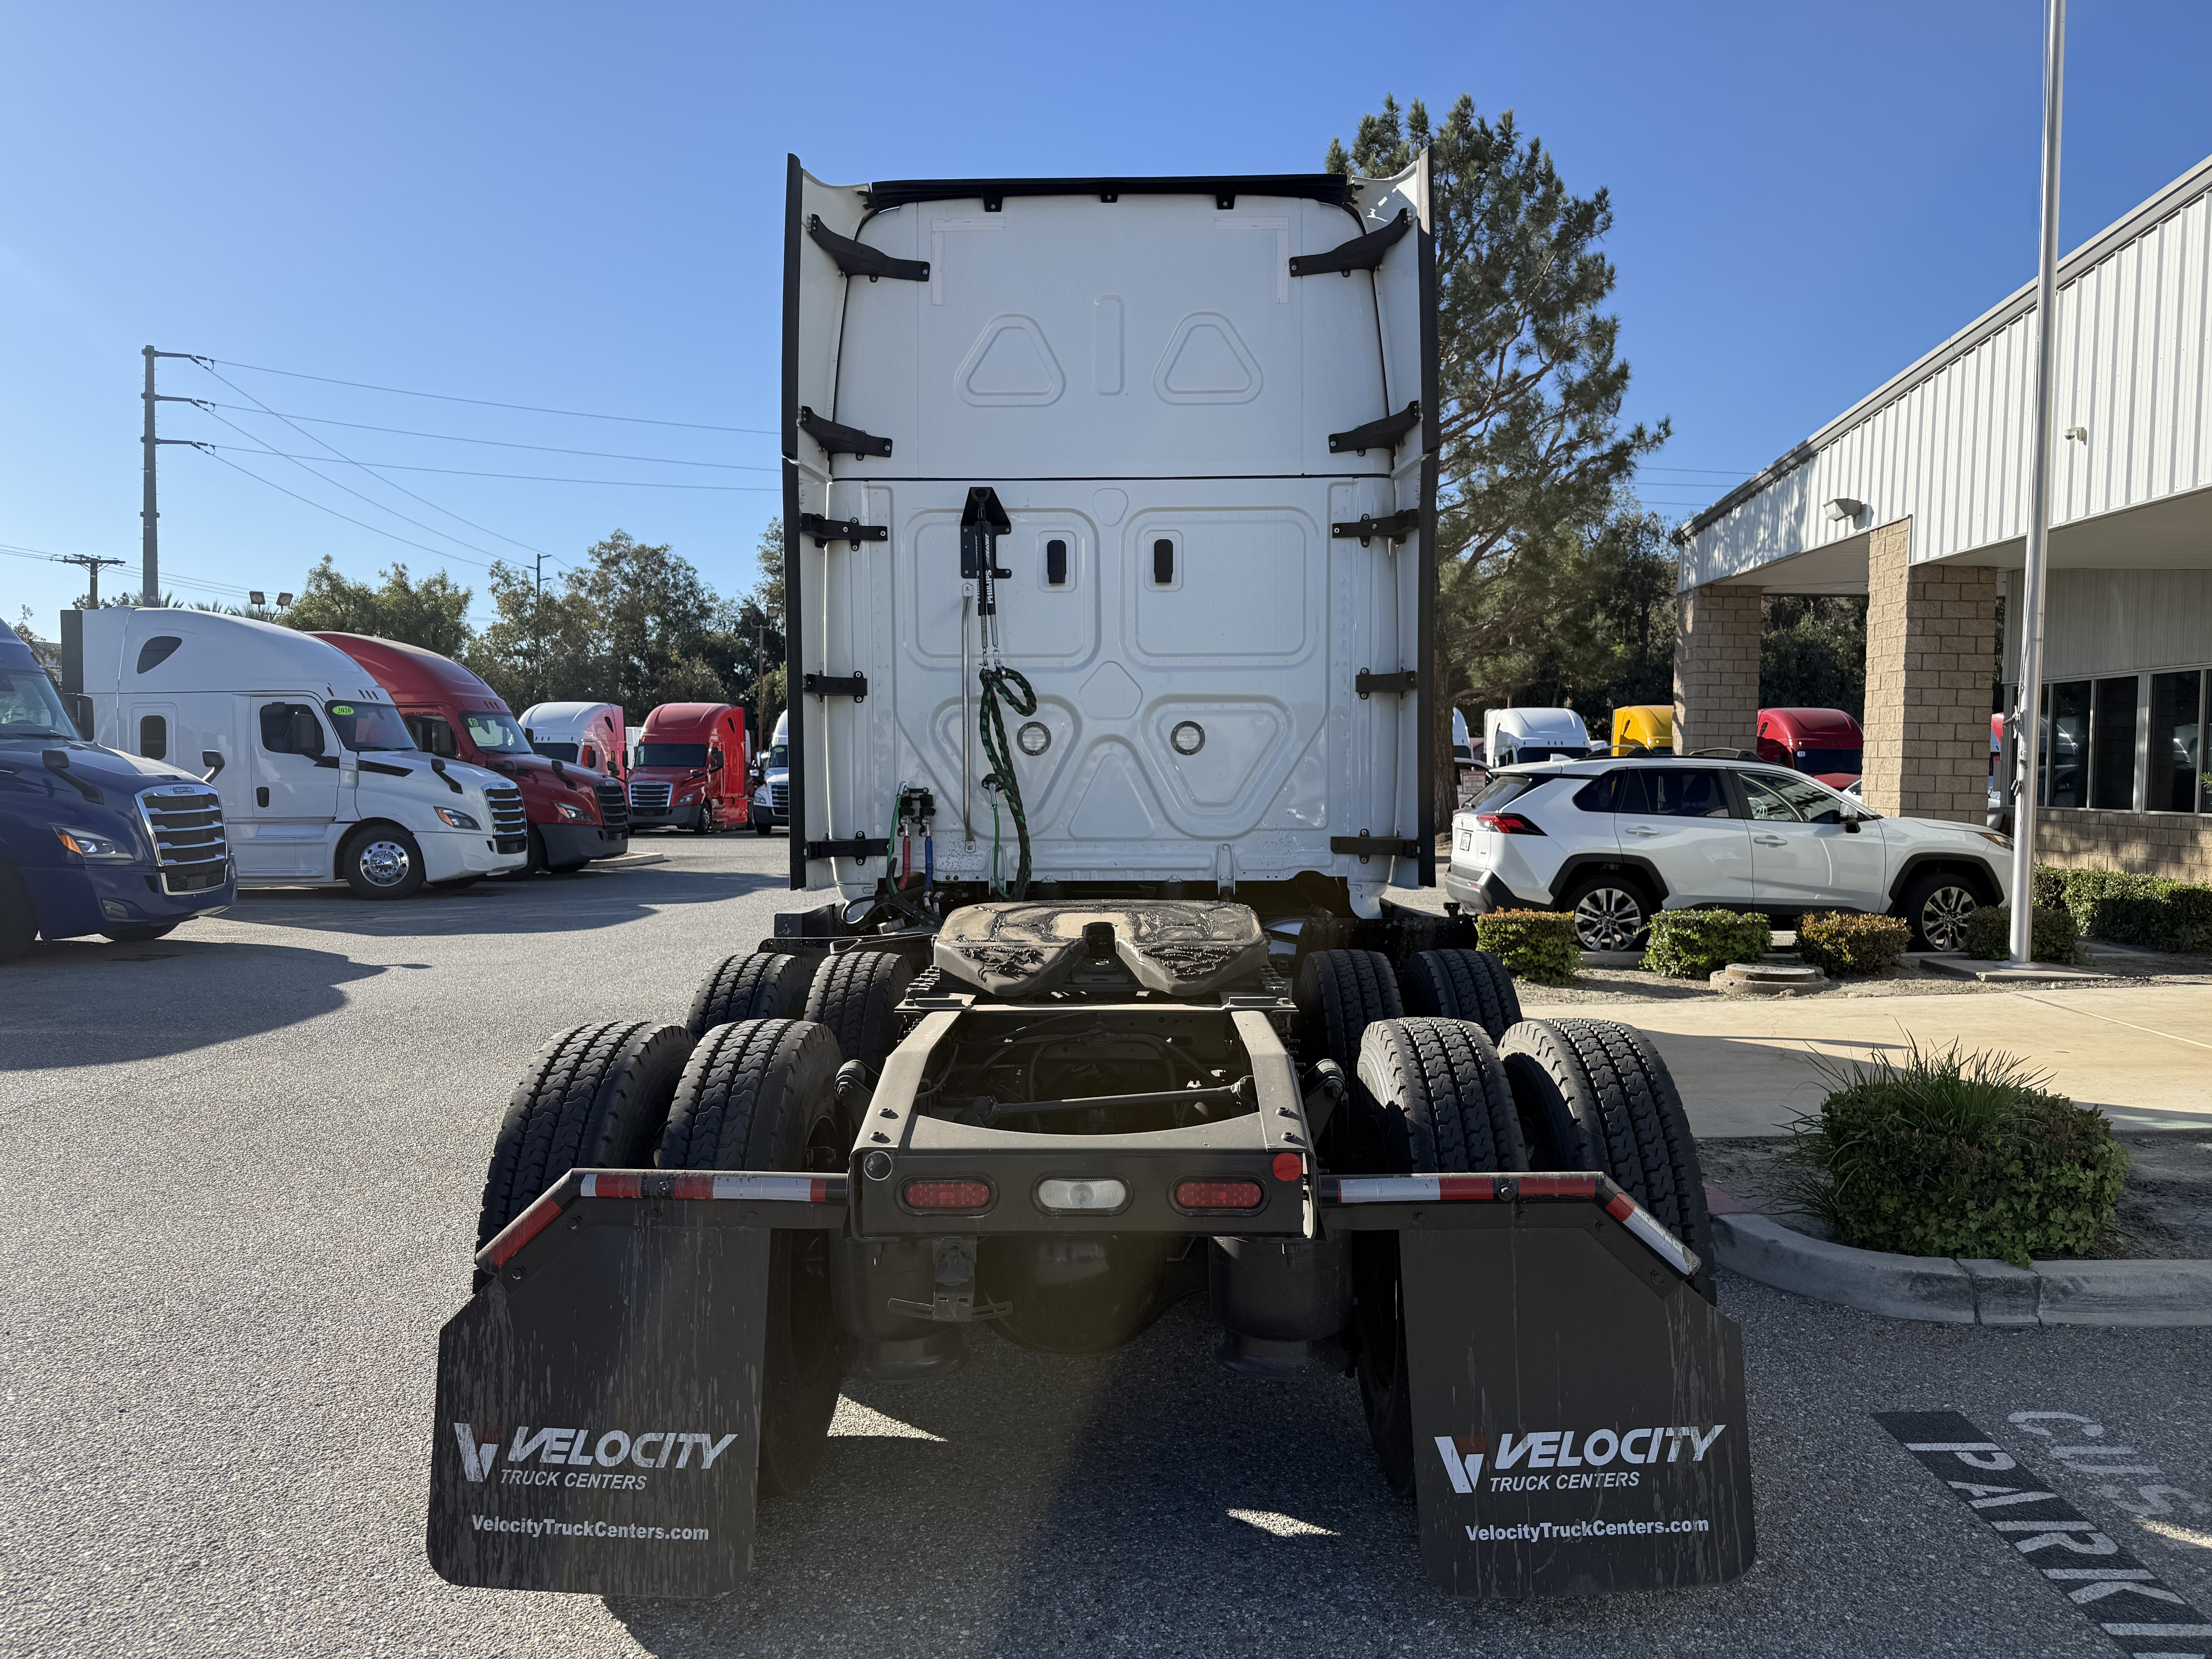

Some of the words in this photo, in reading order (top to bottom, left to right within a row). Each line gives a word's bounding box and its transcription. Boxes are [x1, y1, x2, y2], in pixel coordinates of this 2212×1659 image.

[985, 570, 993, 604] PHILLIPS
[508, 1426, 738, 1469] VELOCITY
[1495, 1424, 1727, 1470] VELOCITY
[501, 1469, 561, 1487] TRUCK
[564, 1472, 647, 1491] CENTERS
[1490, 1475, 1552, 1492] TRUCK
[1556, 1471, 1640, 1489] CENTERS
[472, 1515, 709, 1540] VelocityTruckCenters.com
[1465, 1519, 1709, 1543] VelocityTruckCenters.com
[1905, 1443, 2212, 1659] PARKI
